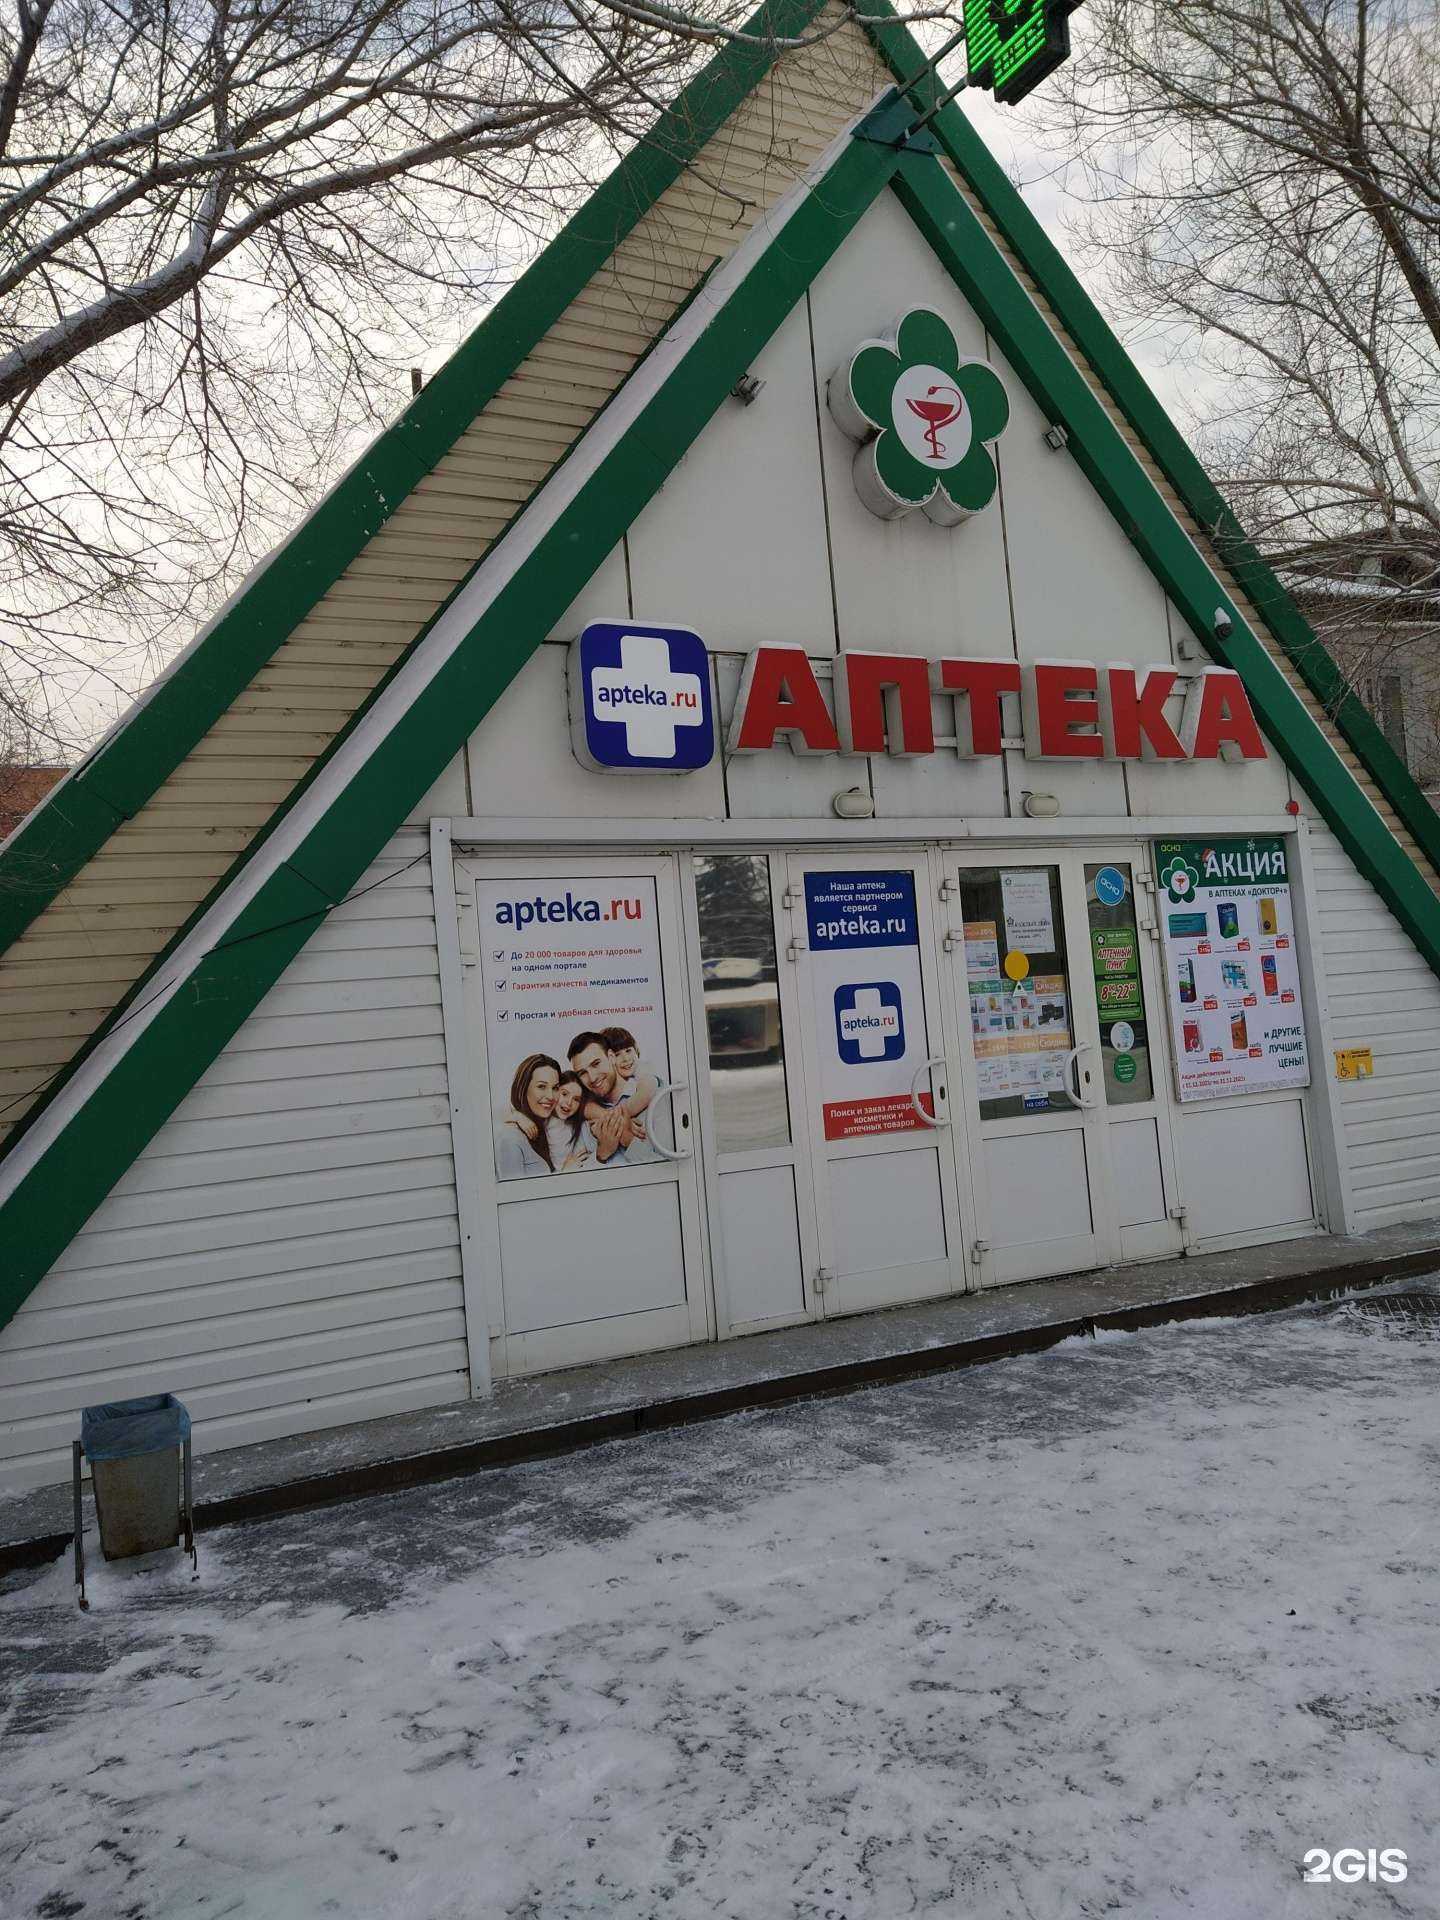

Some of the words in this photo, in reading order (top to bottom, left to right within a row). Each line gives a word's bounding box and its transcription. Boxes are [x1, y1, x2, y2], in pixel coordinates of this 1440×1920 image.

[598, 682, 697, 711] apteka.ru
[735, 648, 1268, 759] АПТЕКА
[1204, 850, 1286, 881] АКЦИЯ
[830, 882, 855, 891] Наша
[856, 881, 886, 891] аптека
[1215, 888, 1246, 897] АПТЕКАХ
[814, 894, 853, 903] является
[855, 892, 904, 902] партнером
[495, 892, 642, 931] apteka.ru
[842, 904, 877, 914] сервиса
[816, 915, 906, 941] apteka.ru
[510, 951, 523, 961] До
[553, 950, 586, 960] товаров
[588, 950, 603, 959] для
[605, 947, 642, 959] здоровья
[524, 963, 552, 973] одном
[553, 962, 587, 972] портале
[512, 980, 550, 991] Гарантия
[552, 979, 588, 989] качества
[589, 976, 649, 987] медикаментов
[514, 1011, 548, 1021] Простая
[557, 1007, 592, 1019] удобная
[593, 1006, 626, 1015] система
[627, 1005, 653, 1013] заказа
[843, 1016, 895, 1031] apteka.ru
[1271, 1026, 1301, 1039] ДРУГИЕ
[1268, 1042, 1303, 1053] ЛУЧШИЕ
[830, 1108, 855, 1118] Поиск
[864, 1107, 886, 1115] заказ
[853, 1113, 896, 1124] косметики
[843, 1124, 881, 1134] аптечных
[883, 1119, 915, 1130] товаров
